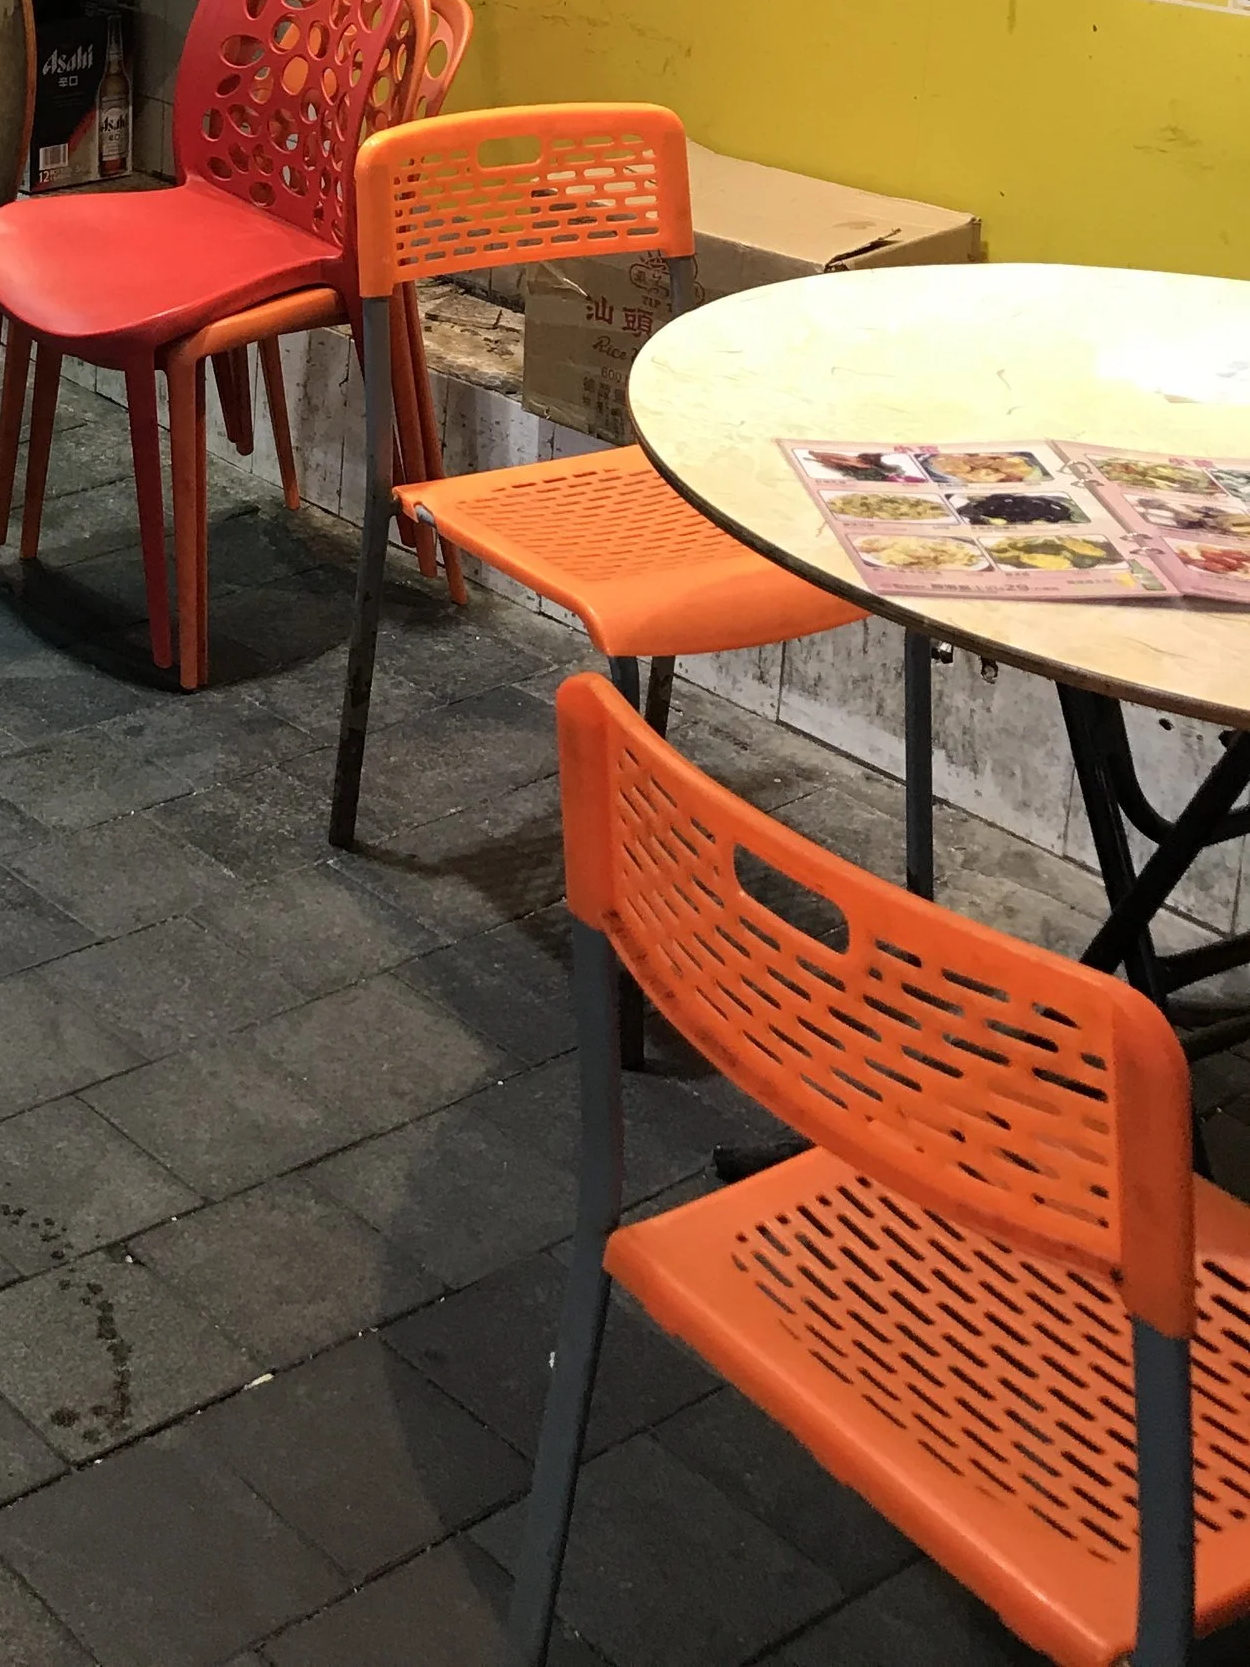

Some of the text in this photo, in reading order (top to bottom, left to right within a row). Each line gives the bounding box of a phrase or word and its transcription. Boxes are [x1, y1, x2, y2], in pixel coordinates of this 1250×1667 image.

[42, 43, 94, 75] Asahi
[39, 171, 50, 183] 12
[586, 295, 654, 338] 汕頭
[592, 335, 627, 361] Rice
